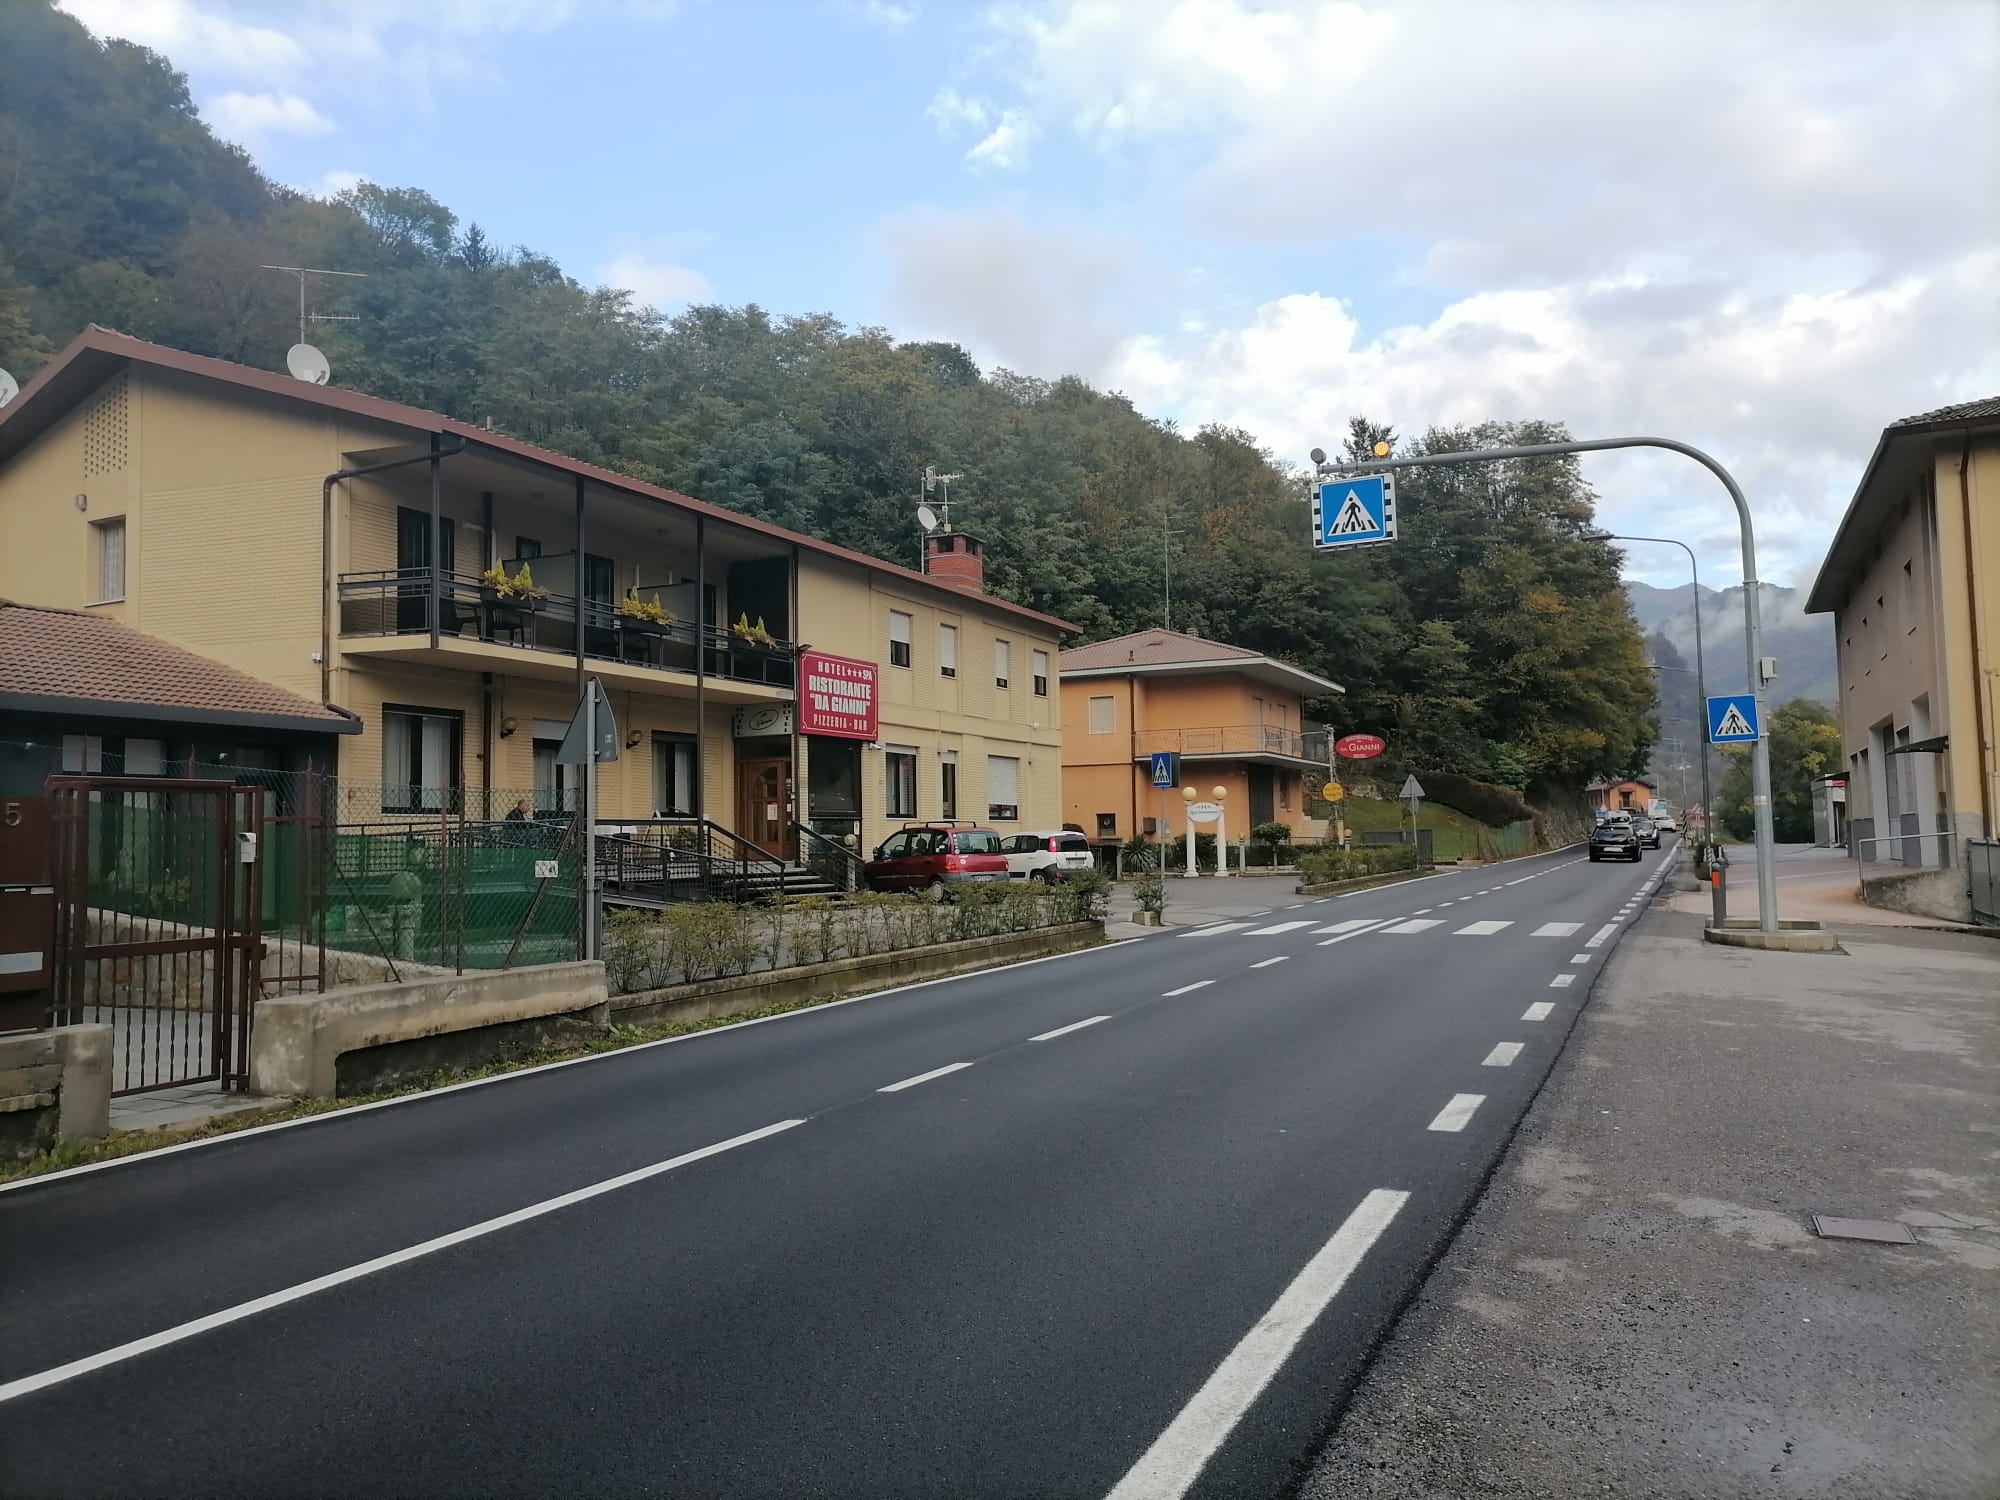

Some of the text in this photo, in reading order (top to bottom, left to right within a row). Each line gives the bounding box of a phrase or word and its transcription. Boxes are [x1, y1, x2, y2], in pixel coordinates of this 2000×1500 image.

[818, 661, 873, 681] HOTEL SPA
[808, 675, 871, 699] RISTORANTE
[813, 713, 867, 731] PIZZERIA BAR
[5, 802, 22, 826] 5
